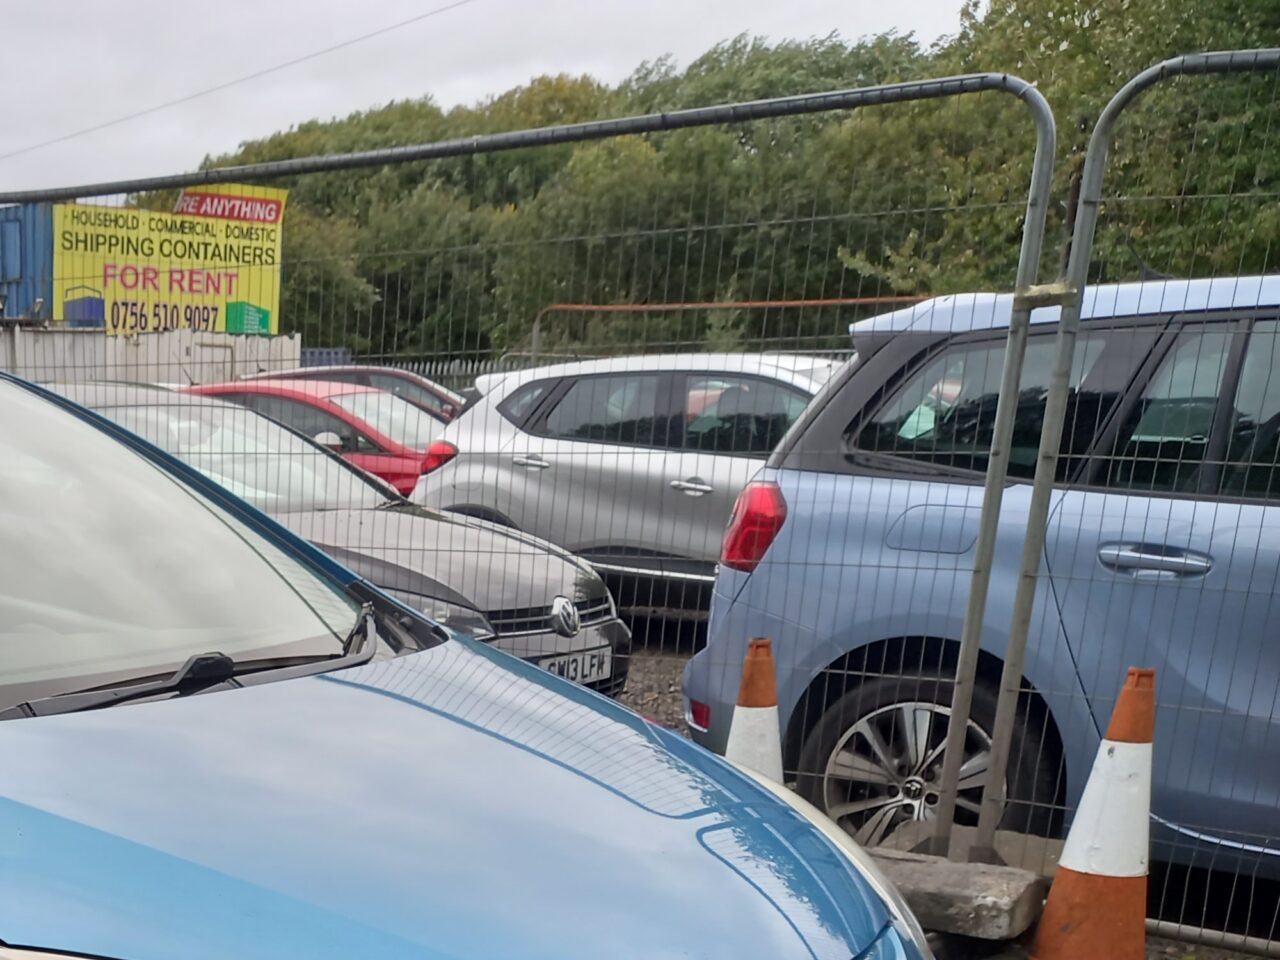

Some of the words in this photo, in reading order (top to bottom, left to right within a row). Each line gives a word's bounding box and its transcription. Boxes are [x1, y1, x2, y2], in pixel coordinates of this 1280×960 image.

[200, 197, 277, 221] ANYTHING
[71, 210, 139, 231] HOUSEHOLD
[148, 217, 217, 238] COMMERCIAL
[225, 223, 276, 243] DOMESTIC
[61, 230, 154, 257] SHIPPING
[159, 238, 275, 266] CONTAINERS
[103, 263, 159, 292] FOR
[170, 269, 238, 297] RENT
[111, 301, 148, 331] 0756
[152, 304, 180, 332] 510
[184, 305, 219, 331] 9097
